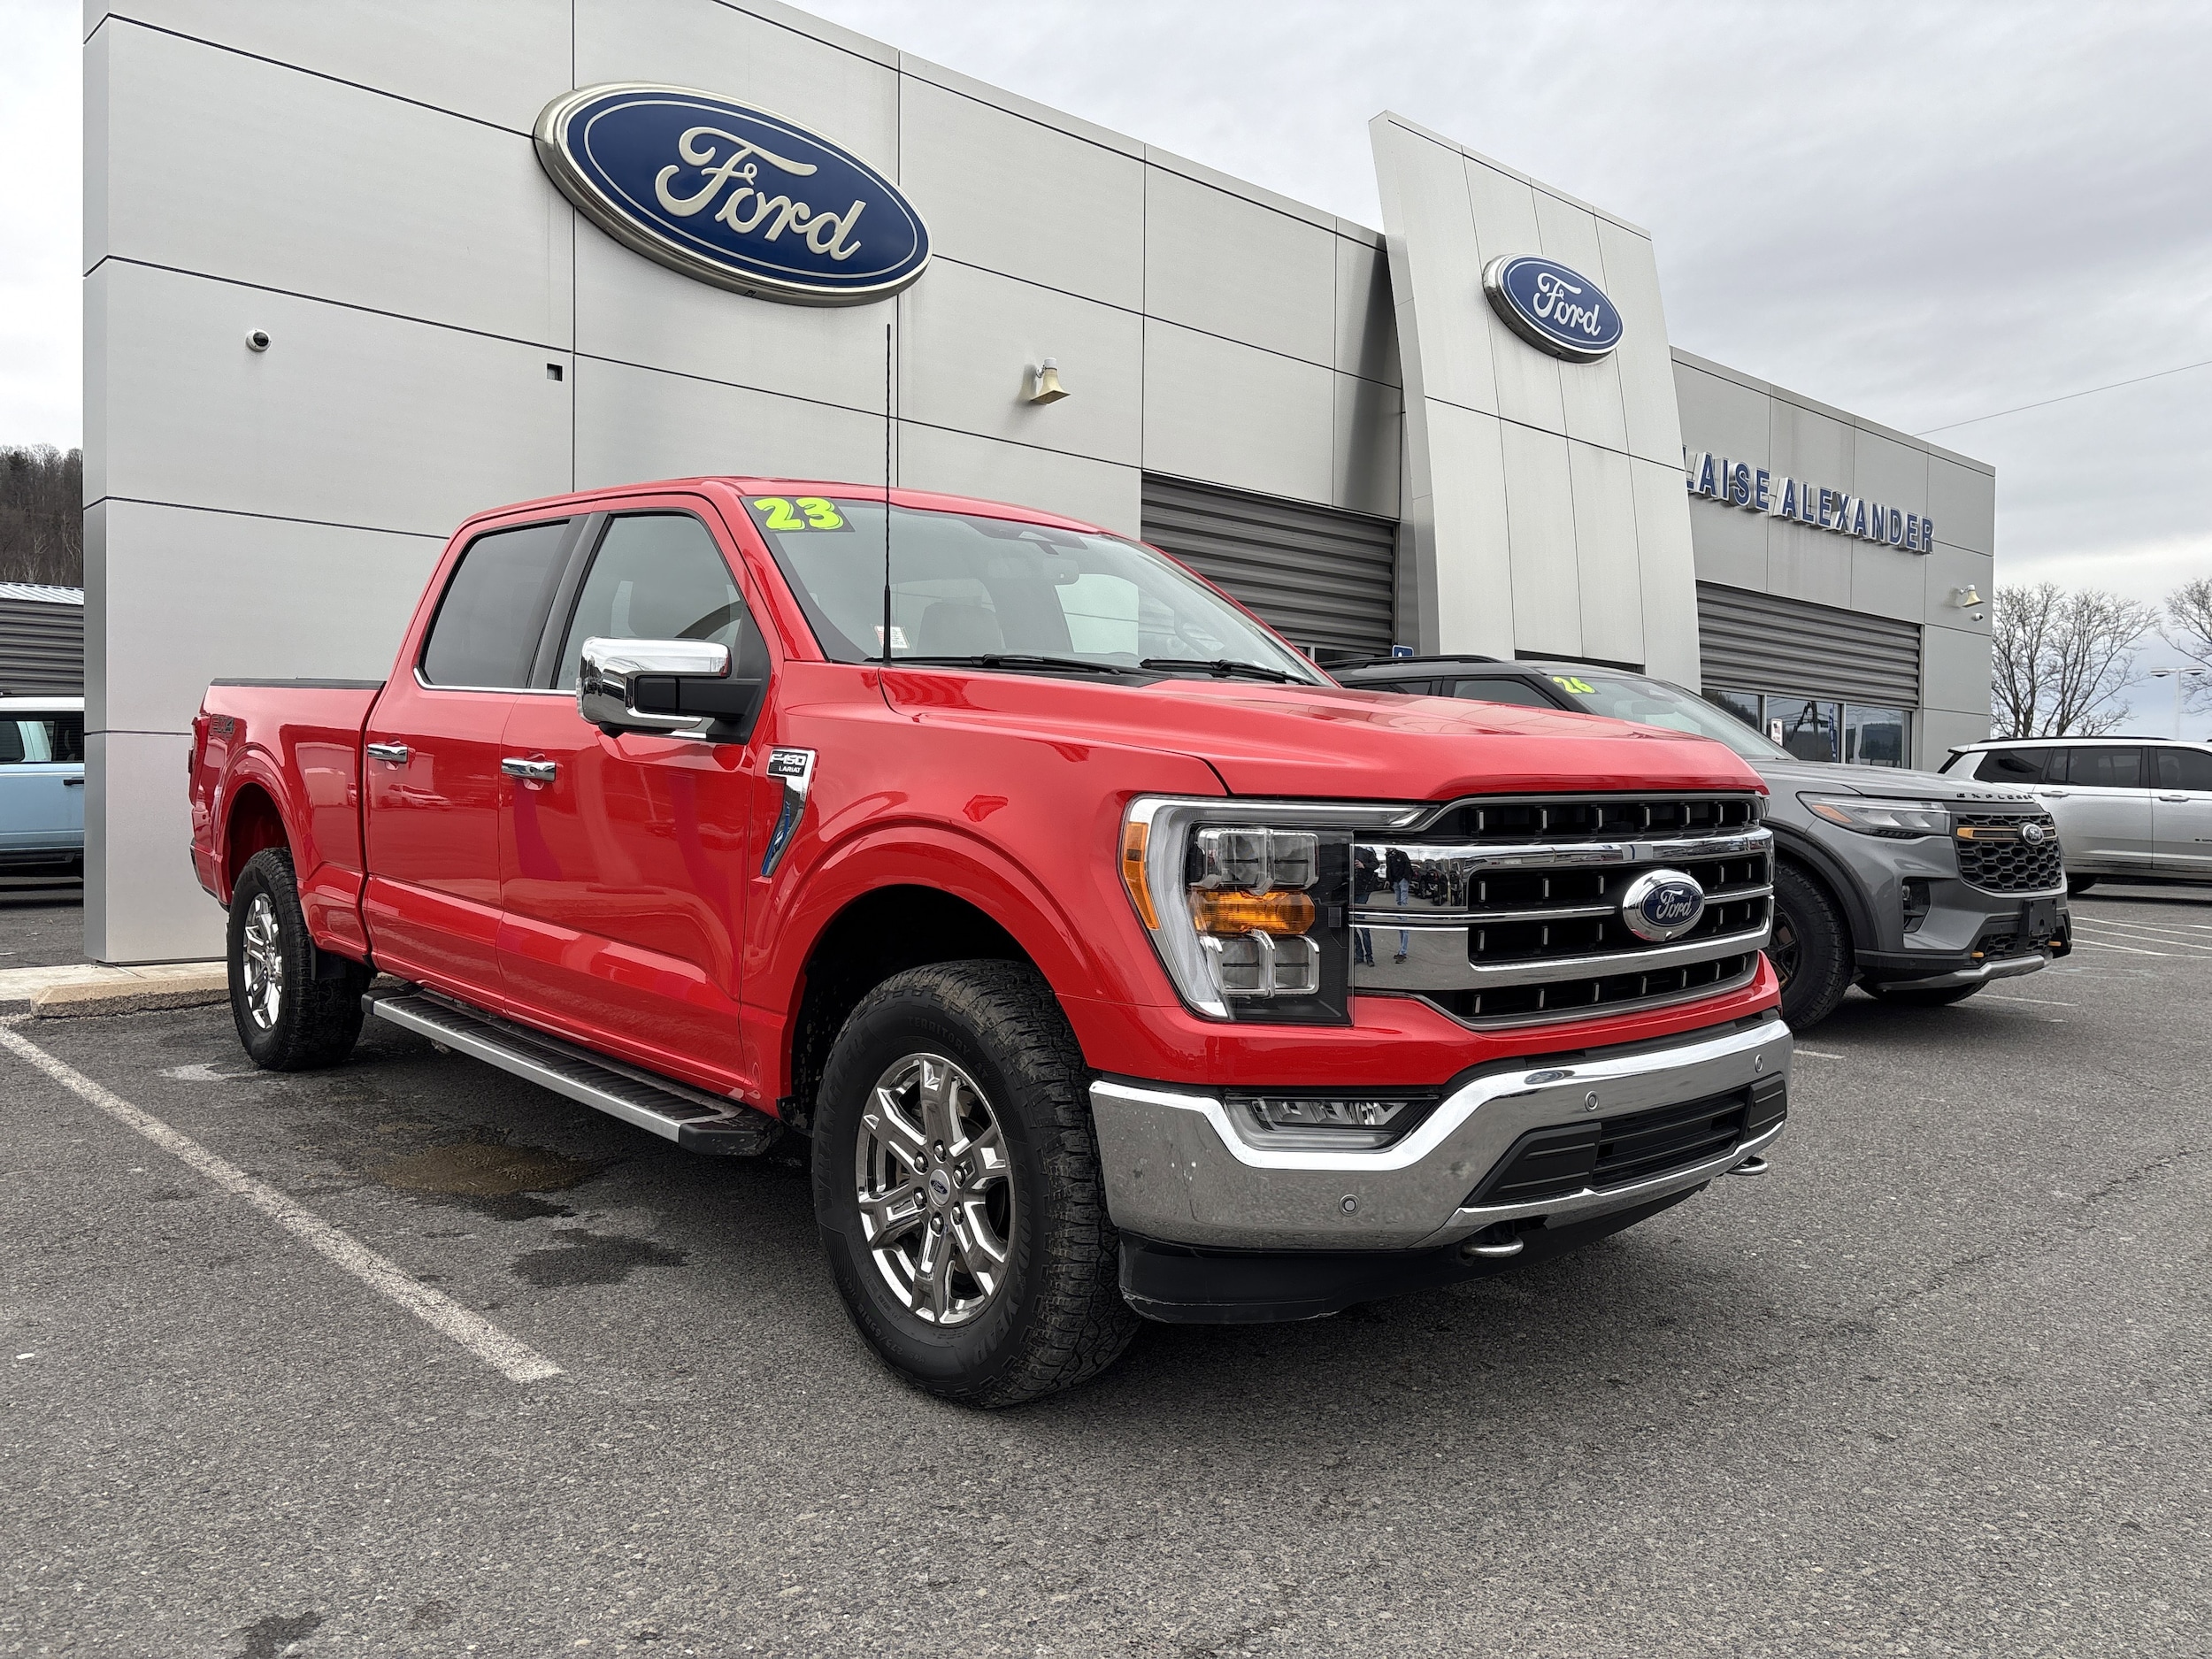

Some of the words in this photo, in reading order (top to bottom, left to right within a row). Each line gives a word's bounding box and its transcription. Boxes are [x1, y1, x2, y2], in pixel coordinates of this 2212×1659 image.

[656, 127, 866, 261] Ford
[1532, 273, 1601, 336] Ford
[753, 497, 844, 530] 23
[1781, 478, 1934, 554] ALEXANDER
[1552, 676, 1595, 694] 26
[770, 753, 807, 766] F-150
[1655, 889, 1693, 919] Ford
[907, 1016, 970, 1056] TERRITORY
